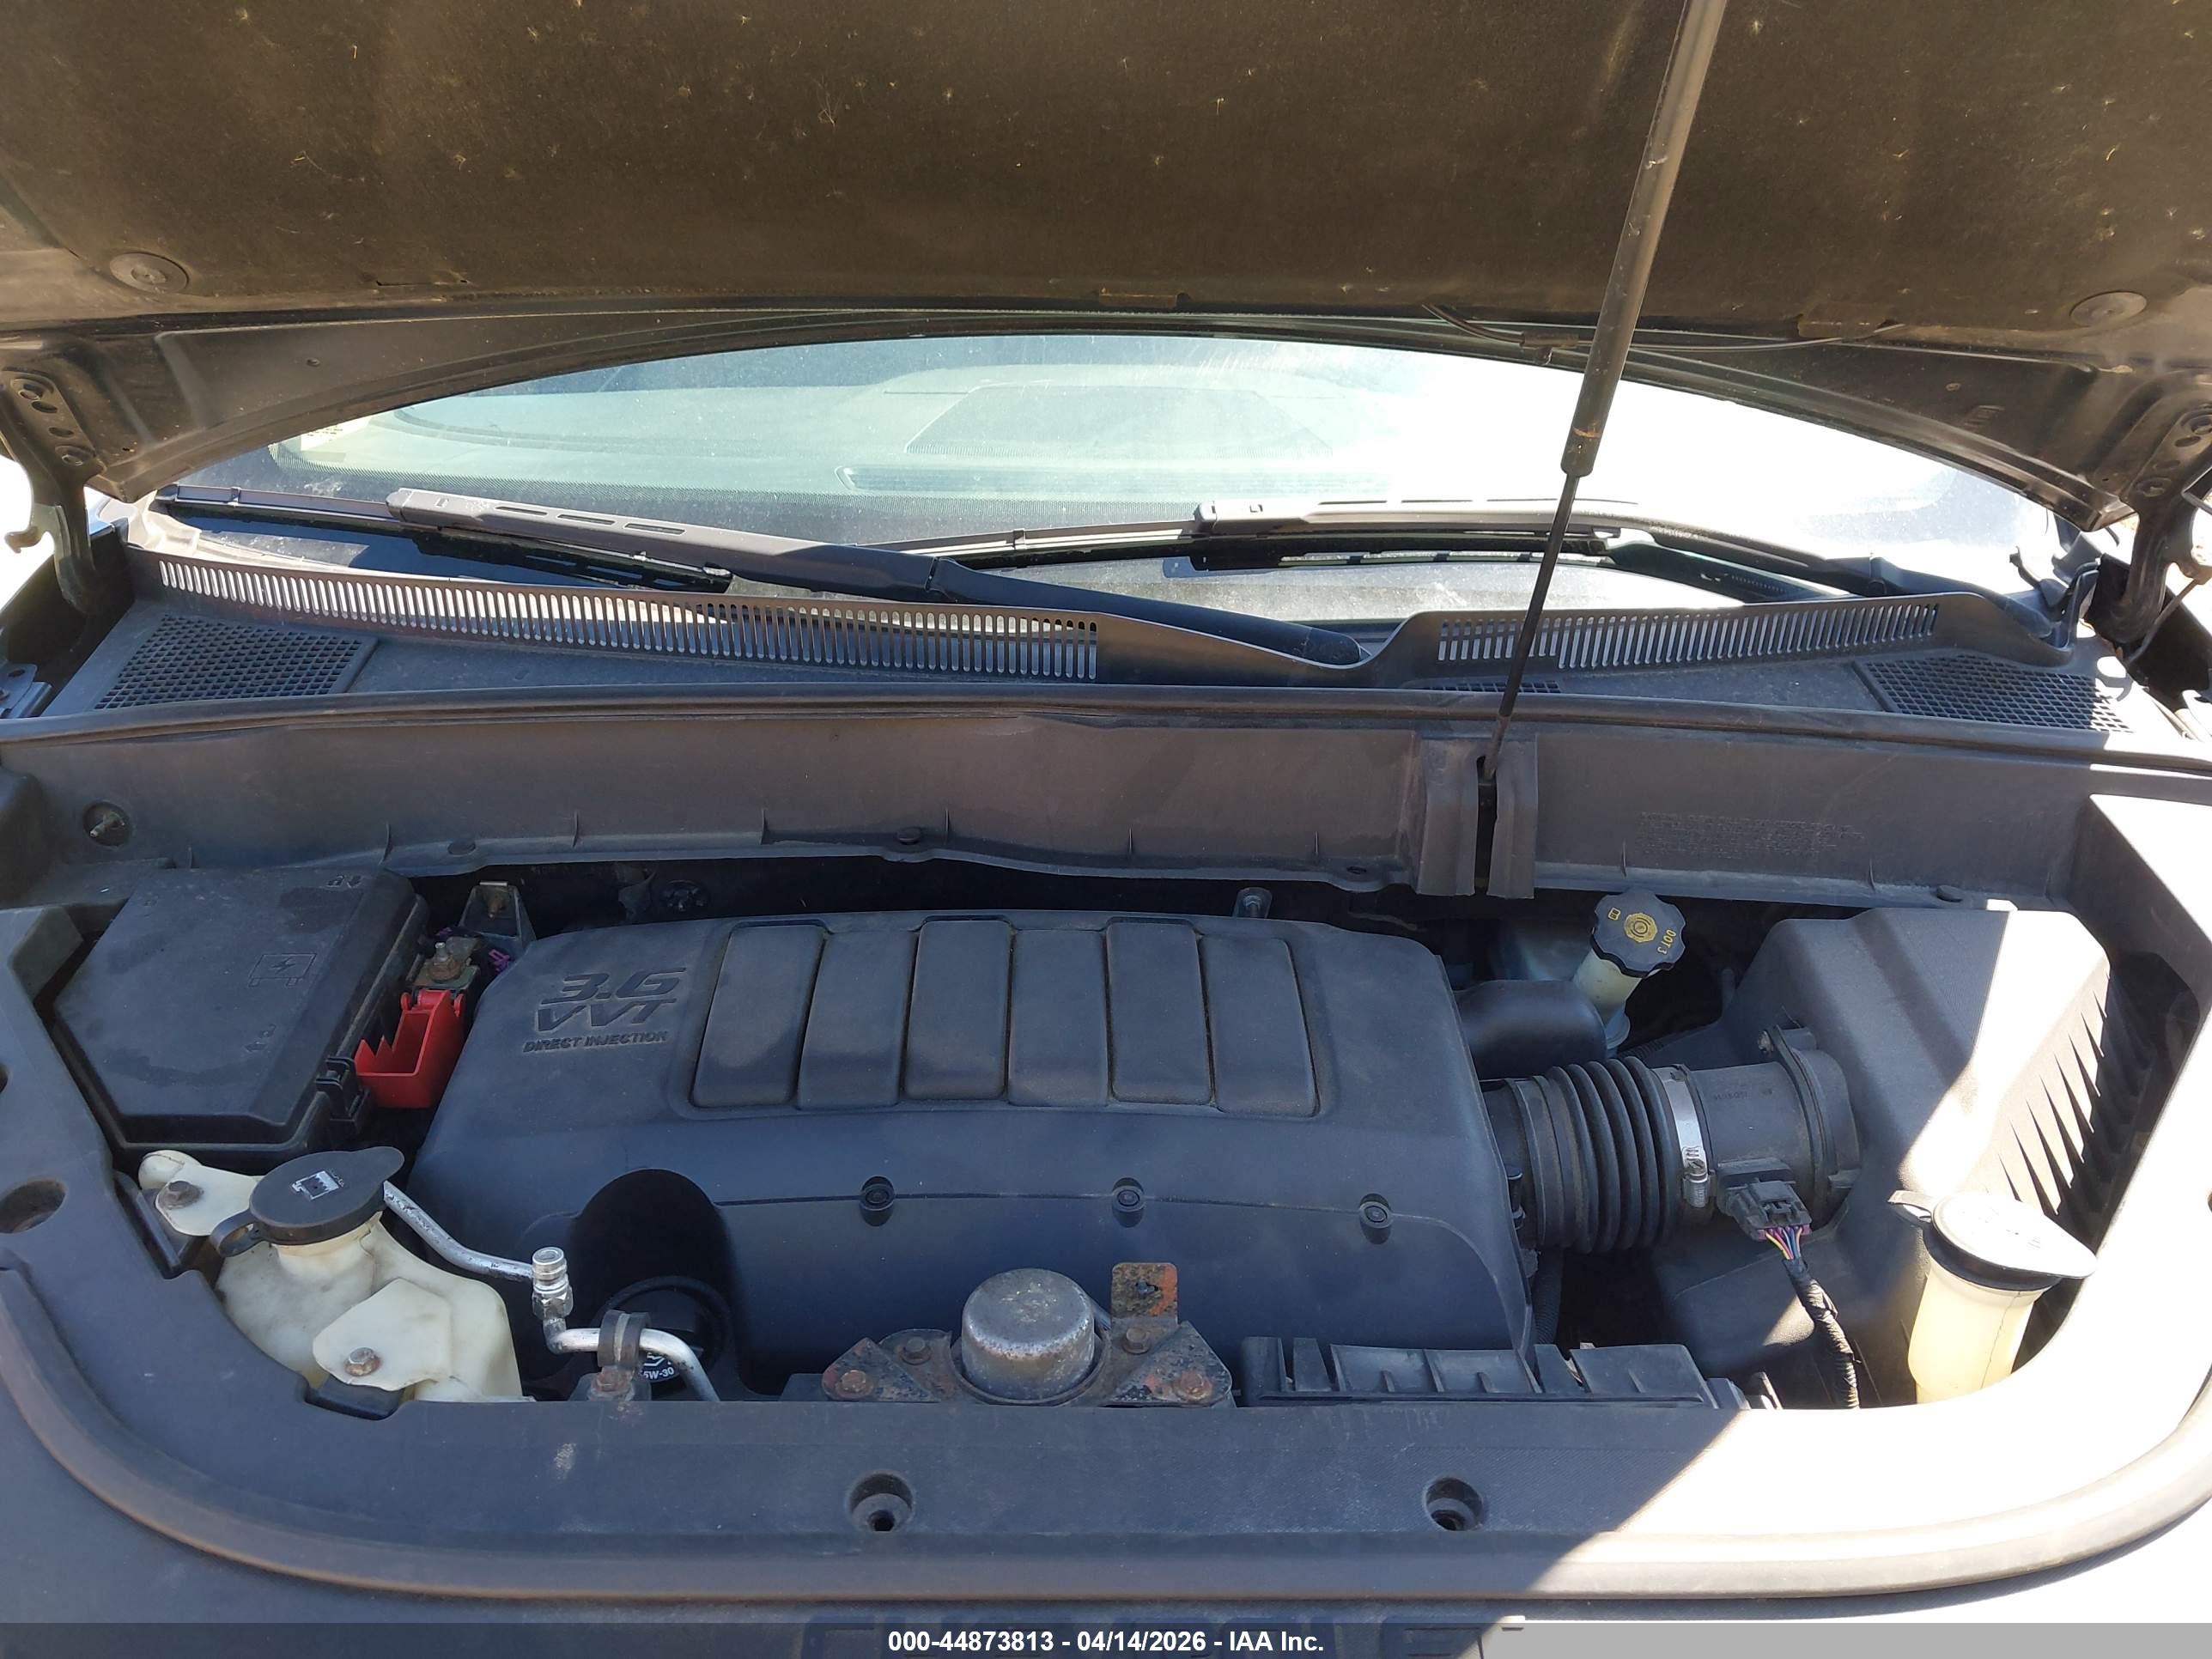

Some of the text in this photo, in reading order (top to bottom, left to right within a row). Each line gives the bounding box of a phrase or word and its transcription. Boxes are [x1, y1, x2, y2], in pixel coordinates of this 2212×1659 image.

[1662, 929, 1676, 948] DOT
[541, 967, 686, 1005] 3.6
[538, 998, 677, 1031] VVT
[522, 1030, 667, 1053] DIRECT INJECTION
